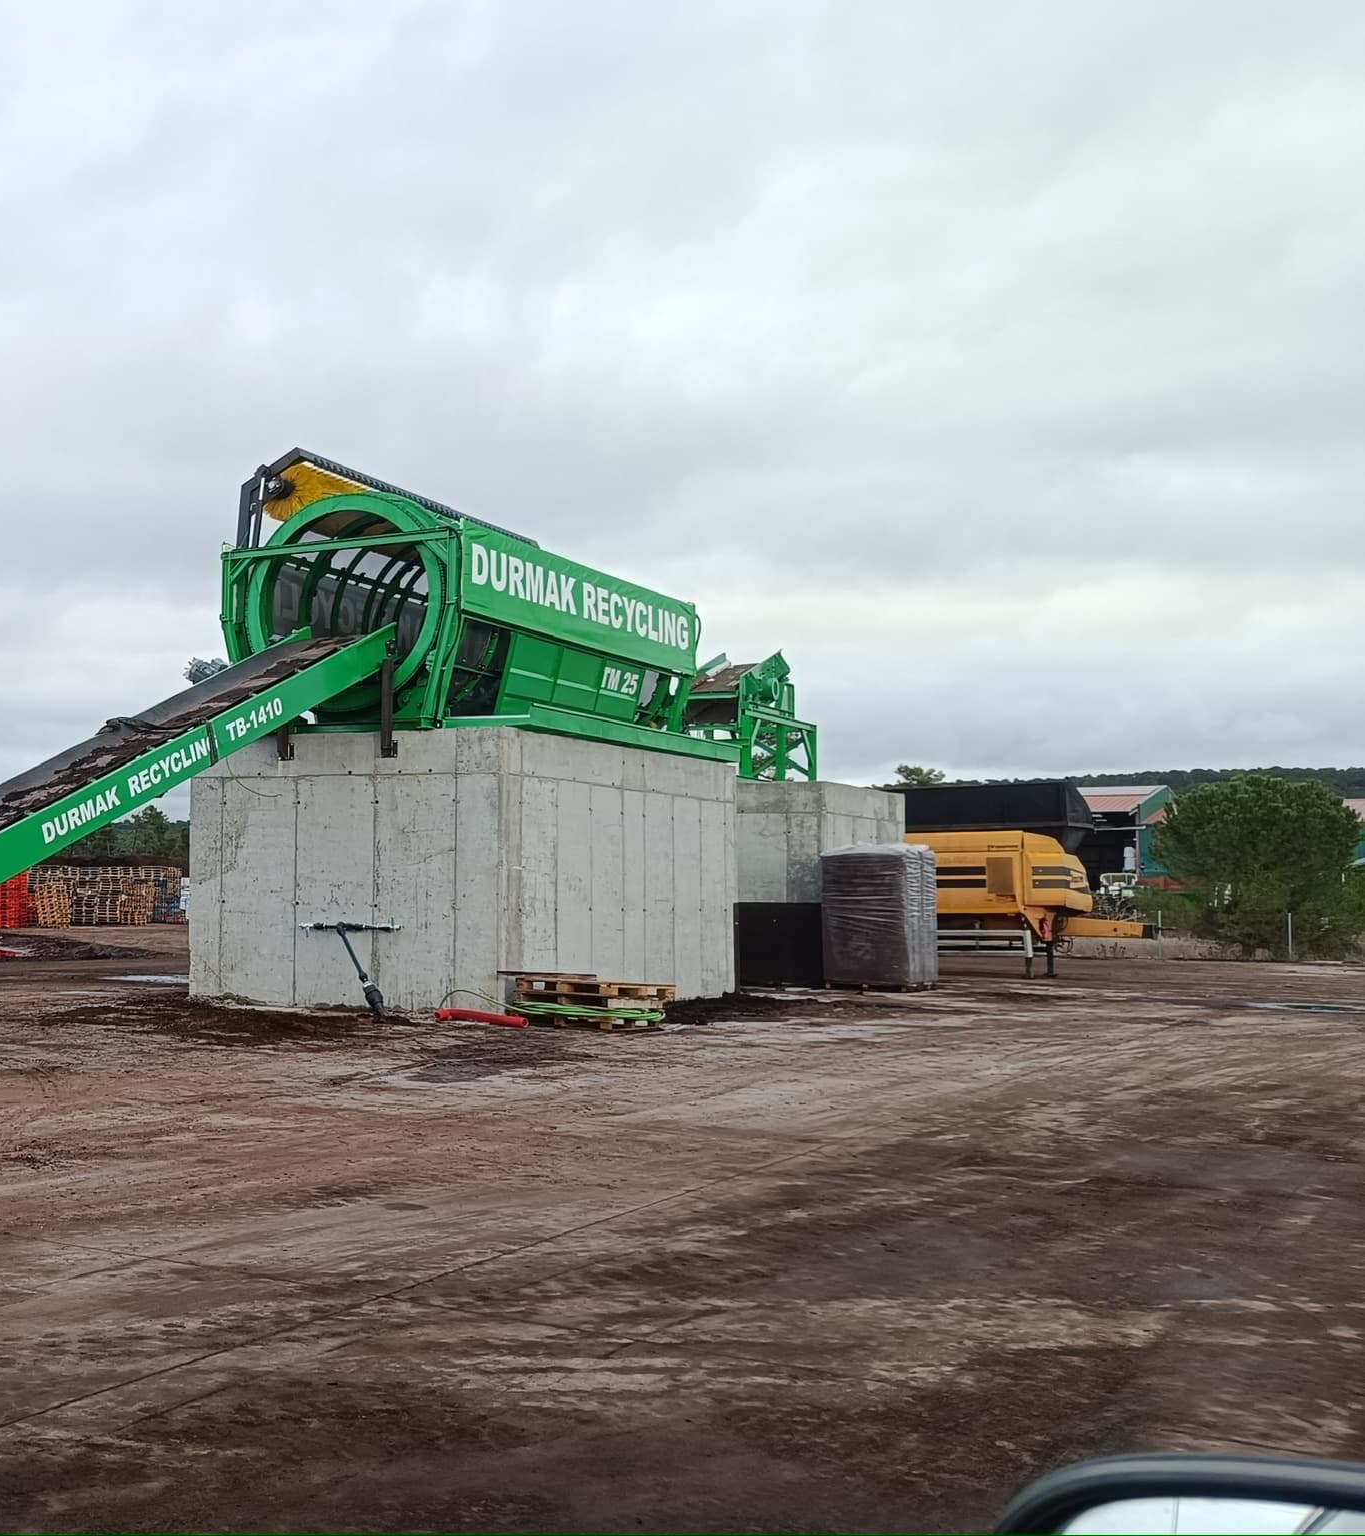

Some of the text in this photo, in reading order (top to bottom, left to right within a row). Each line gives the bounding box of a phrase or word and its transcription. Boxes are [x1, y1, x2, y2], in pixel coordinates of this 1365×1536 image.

[471, 543, 689, 650] DURMAK RECYCLING
[601, 666, 639, 695] TM 25
[41, 786, 121, 844] DURMAK
[225, 697, 283, 741] TB-1410
